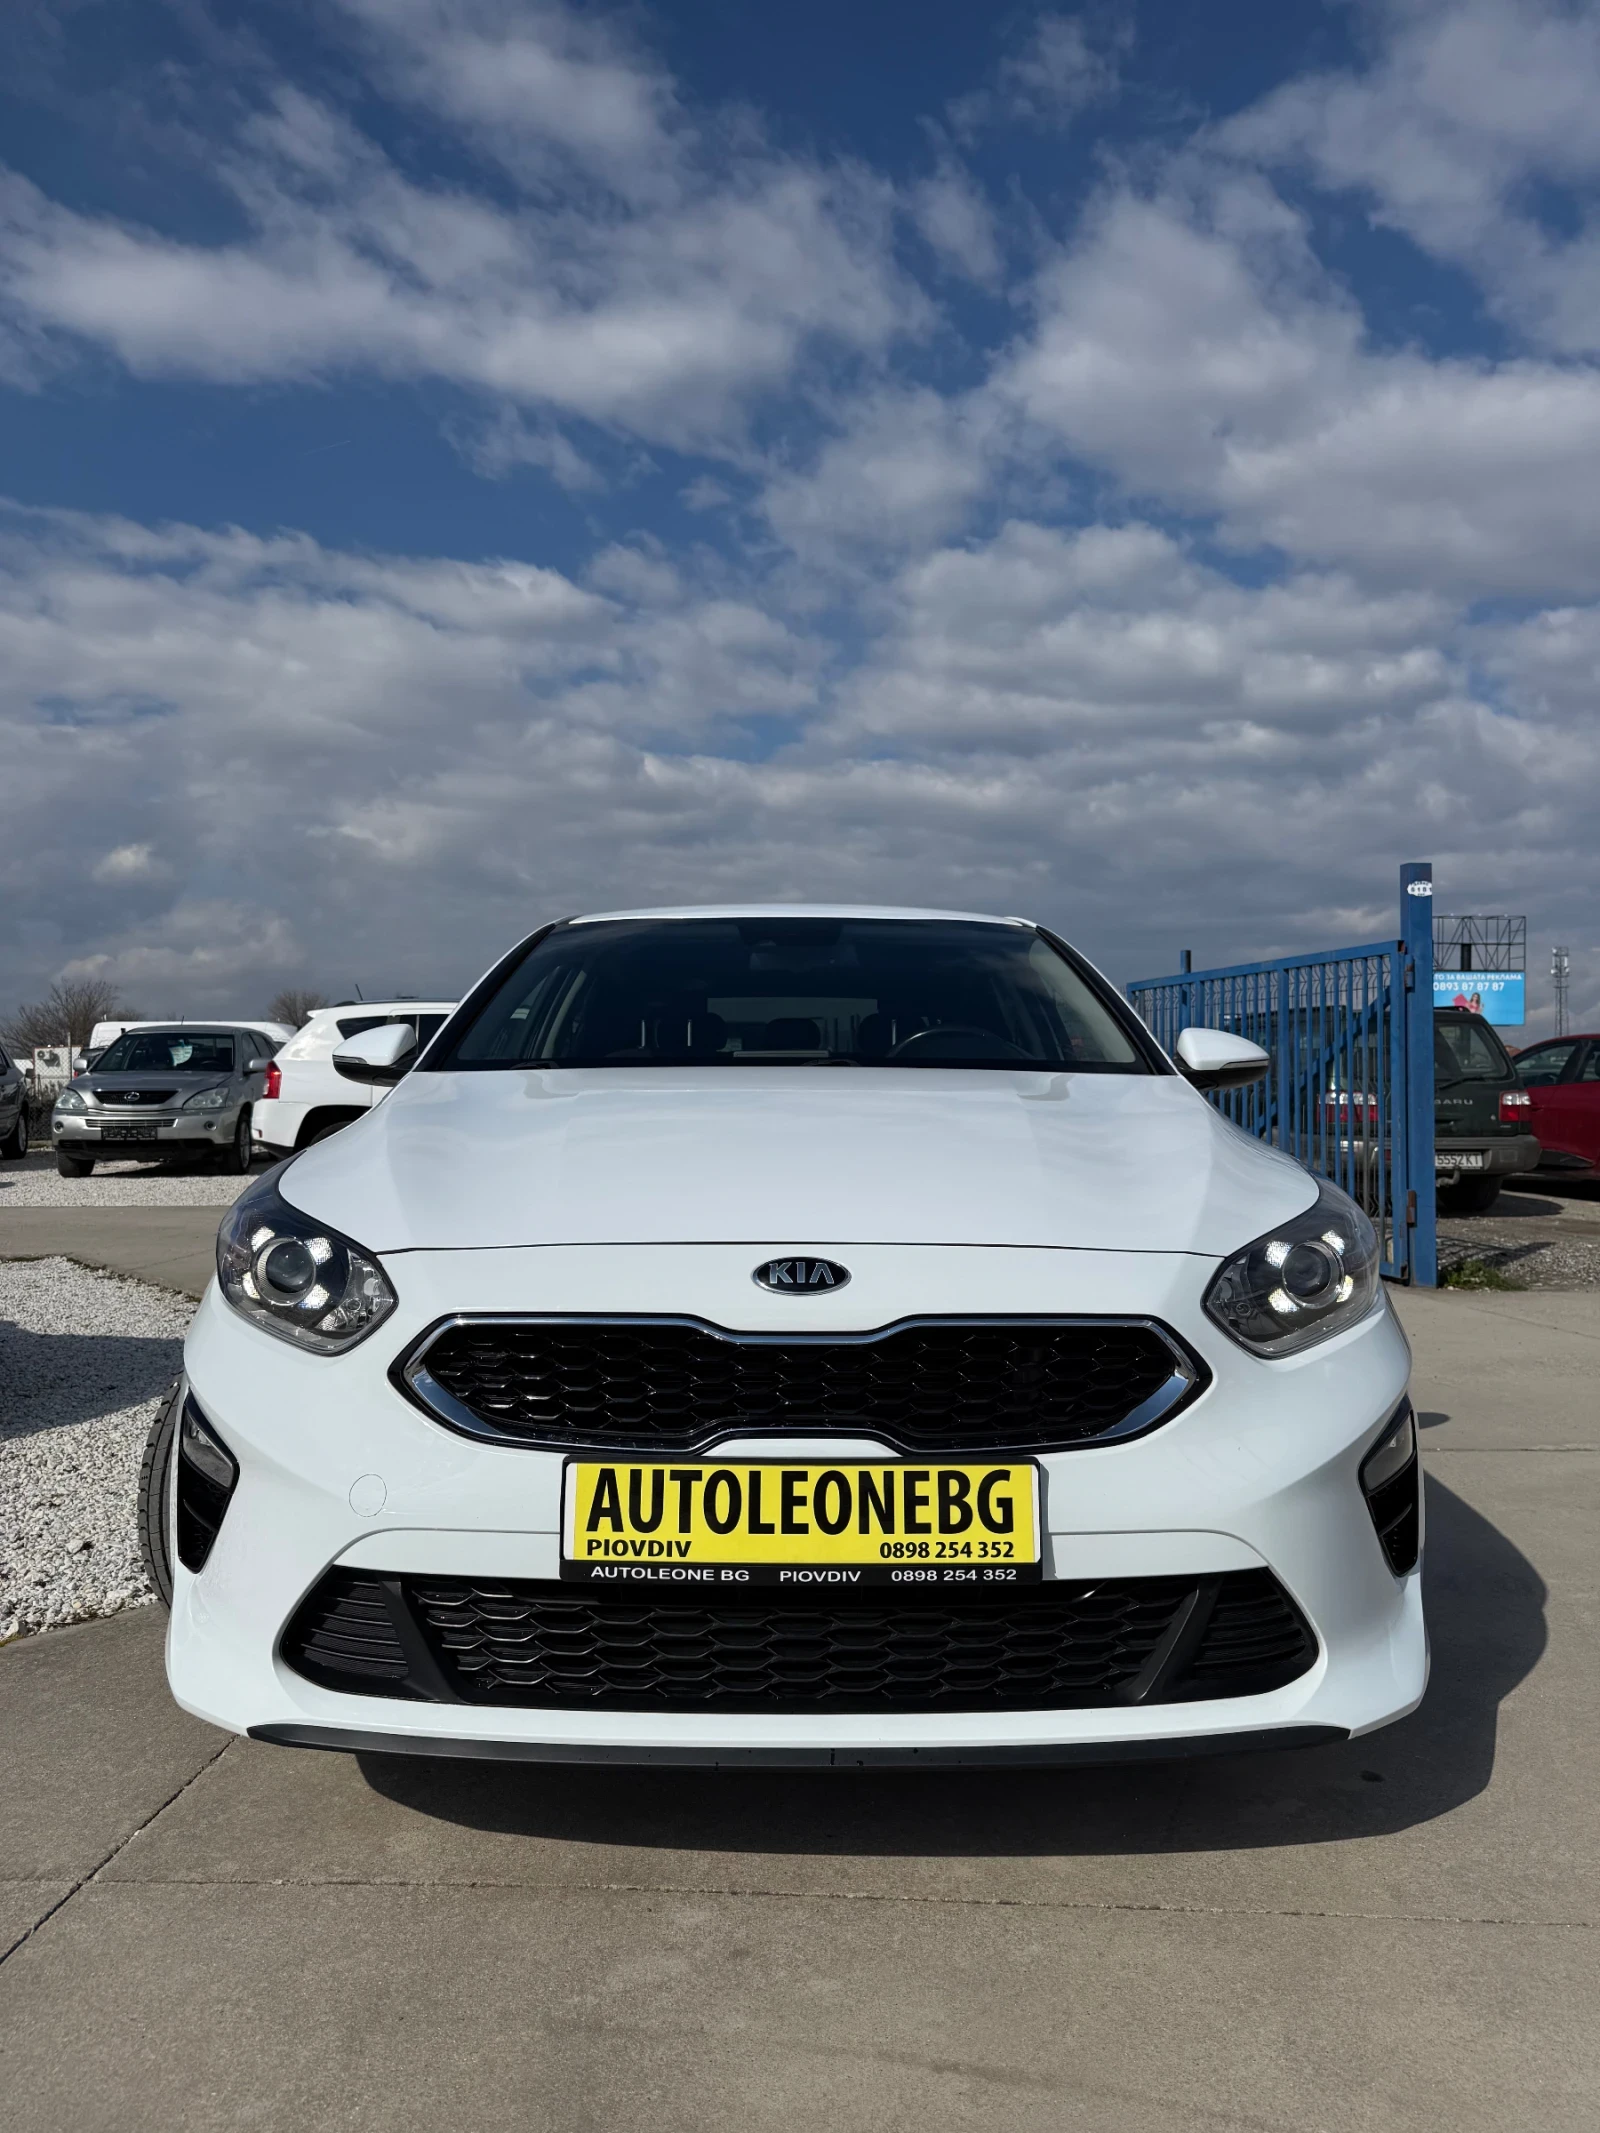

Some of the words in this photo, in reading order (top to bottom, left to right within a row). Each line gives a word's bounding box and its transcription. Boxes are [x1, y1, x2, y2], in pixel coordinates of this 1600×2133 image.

[1486, 973, 1522, 981] РЕКЛАМА
[1433, 982, 1459, 991] 0893
[1462, 982, 1475, 991] 87
[1477, 982, 1490, 991] 87
[1492, 982, 1505, 991] 87
[768, 1261, 835, 1284] KIA
[585, 1467, 1014, 1536] AUTOLEONEBG
[586, 1538, 692, 1558] PIOVDIV
[879, 1541, 931, 1559] 0898
[934, 1541, 973, 1559] 254
[977, 1541, 1015, 1559] 352
[590, 1566, 715, 1581] AUTOLEONE
[720, 1569, 750, 1582] BG
[779, 1570, 861, 1583] PIOVDIV
[891, 1569, 938, 1582] 0898
[943, 1569, 978, 1581] 254
[983, 1568, 1017, 1581] 352
